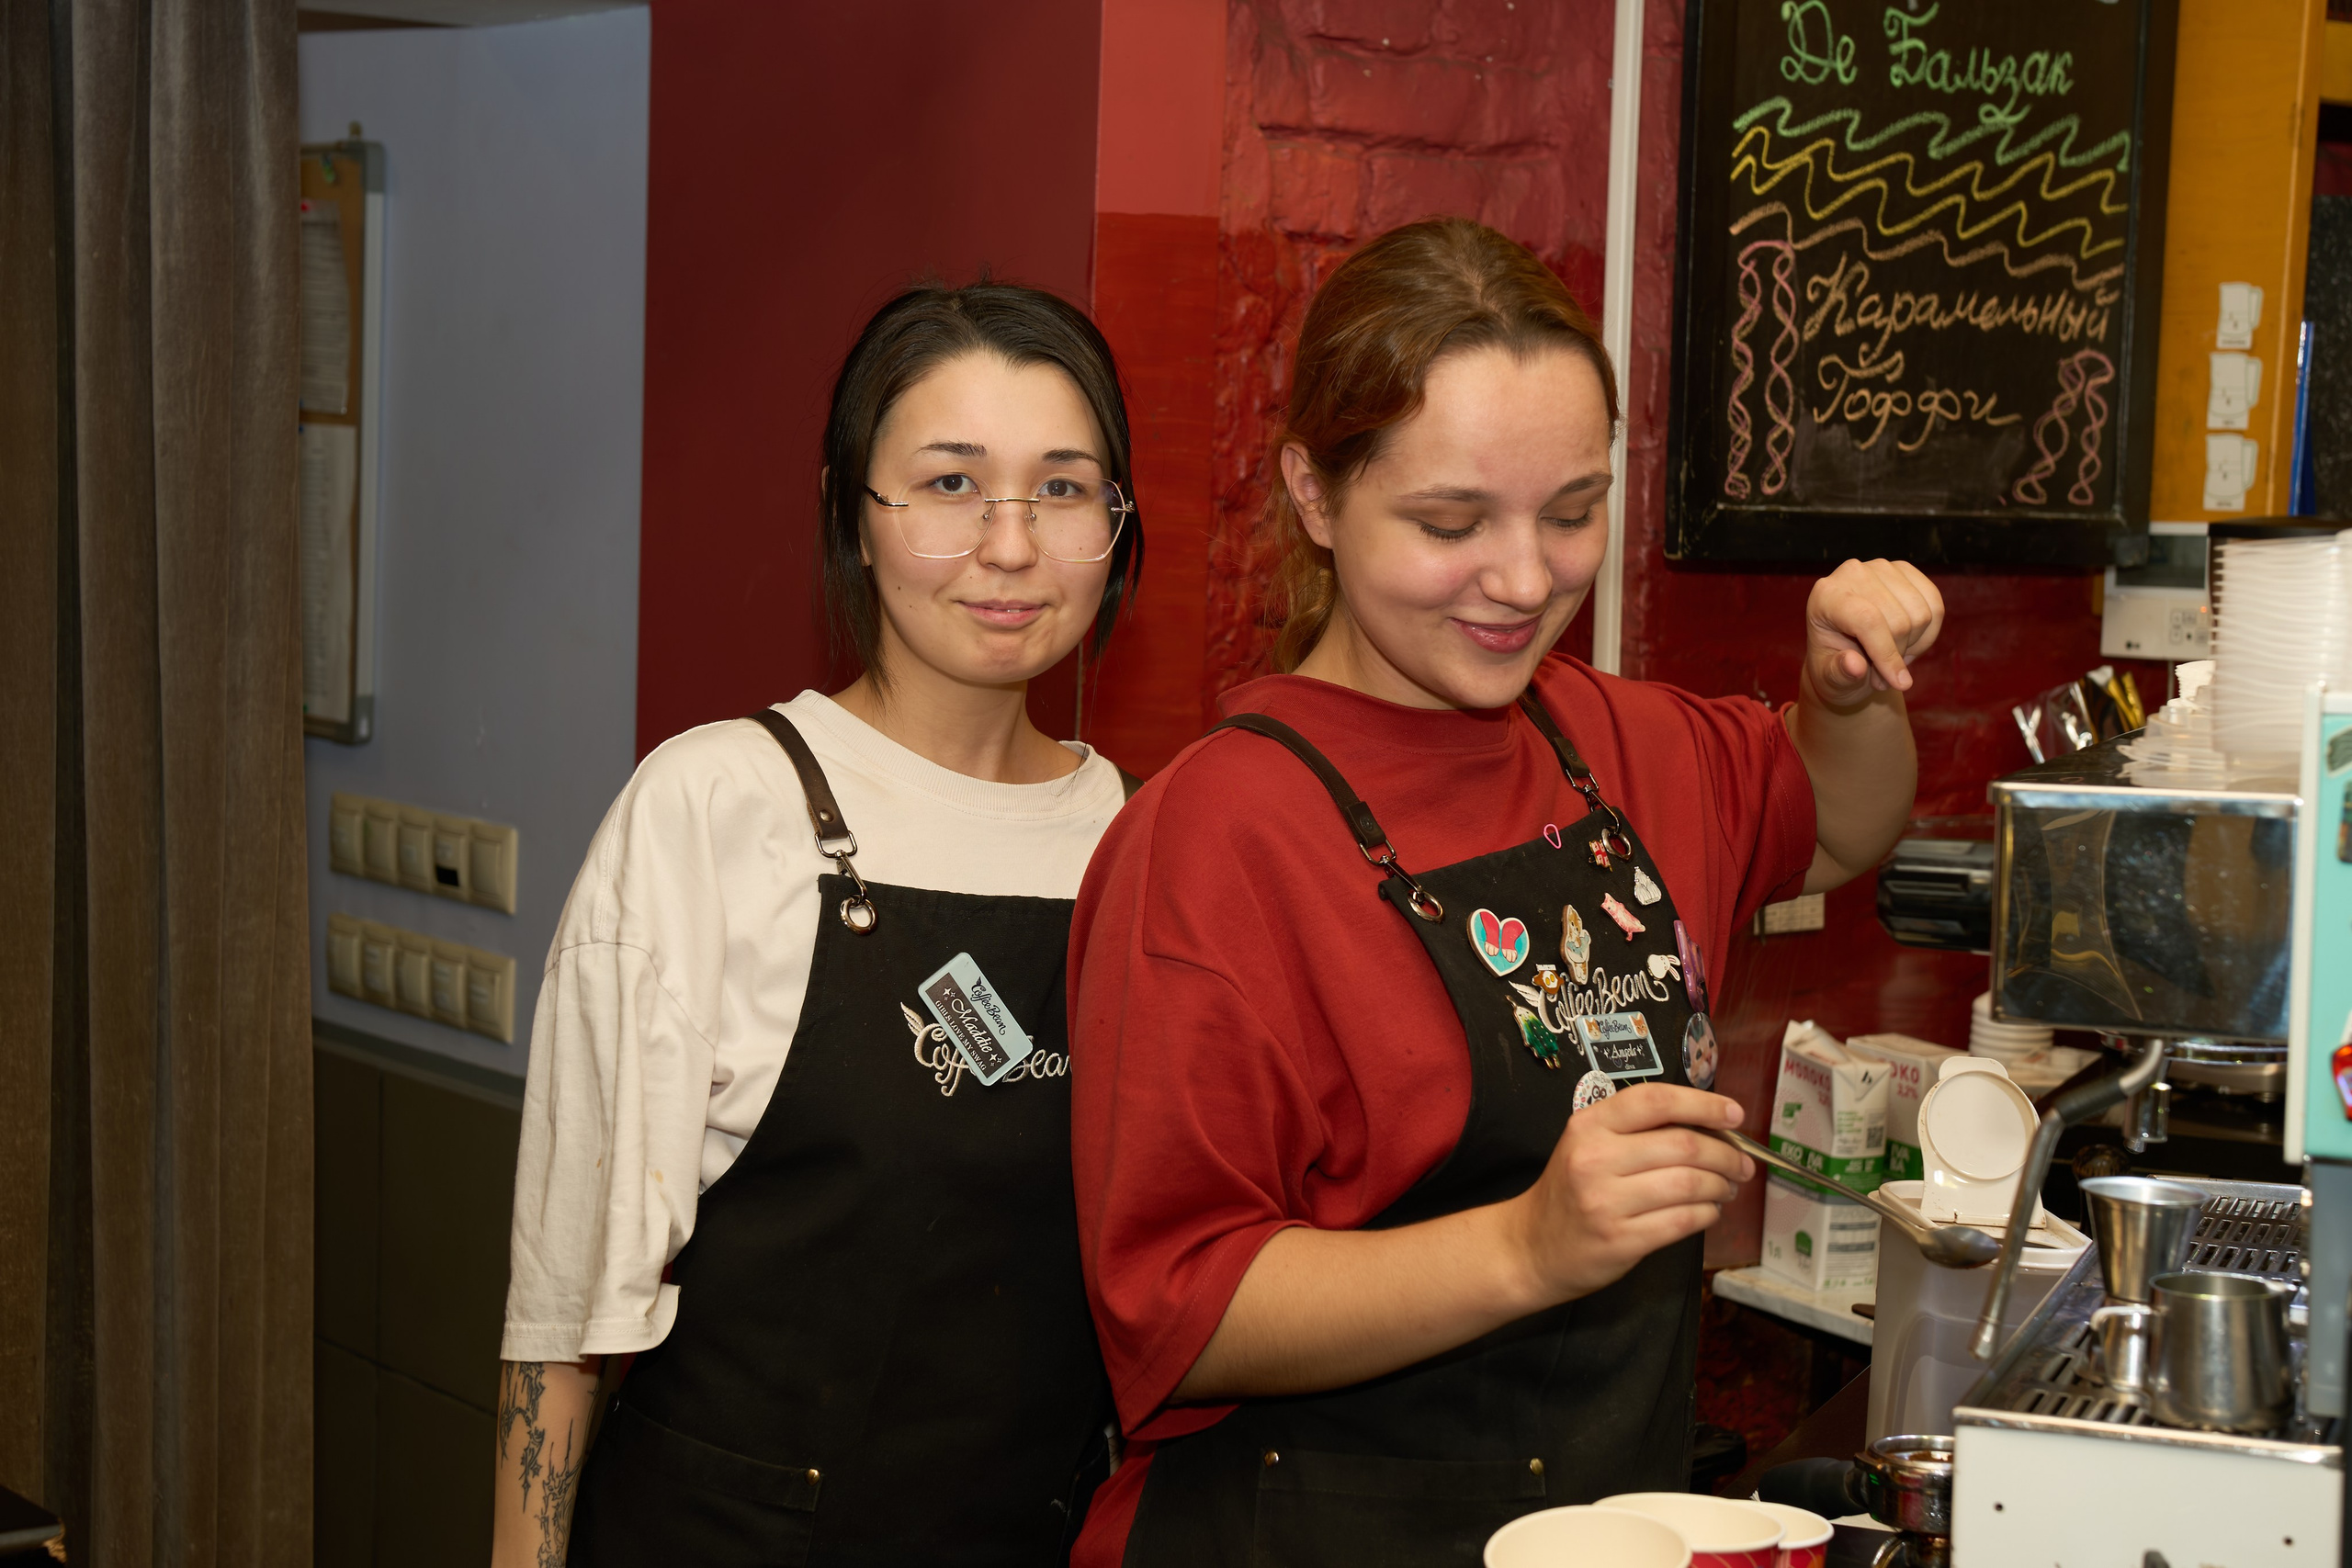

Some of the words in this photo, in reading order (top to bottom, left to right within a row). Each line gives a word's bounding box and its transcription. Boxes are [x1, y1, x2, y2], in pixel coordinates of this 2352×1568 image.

[1781, 0, 1858, 85] Де
[1883, 4, 2075, 124] Бальзак
[1804, 252, 2120, 367] Карамельный
[1814, 351, 2020, 450] Тоффи
[913, 1022, 977, 1097] Coff
[935, 1000, 952, 1023] GIRLS
[950, 1021, 966, 1041] LOVE
[962, 1037, 973, 1051] MY
[971, 1049, 987, 1071] SWAG
[951, 998, 993, 1053] Maddie
[1784, 1057, 1831, 1092] МОЛОКО
